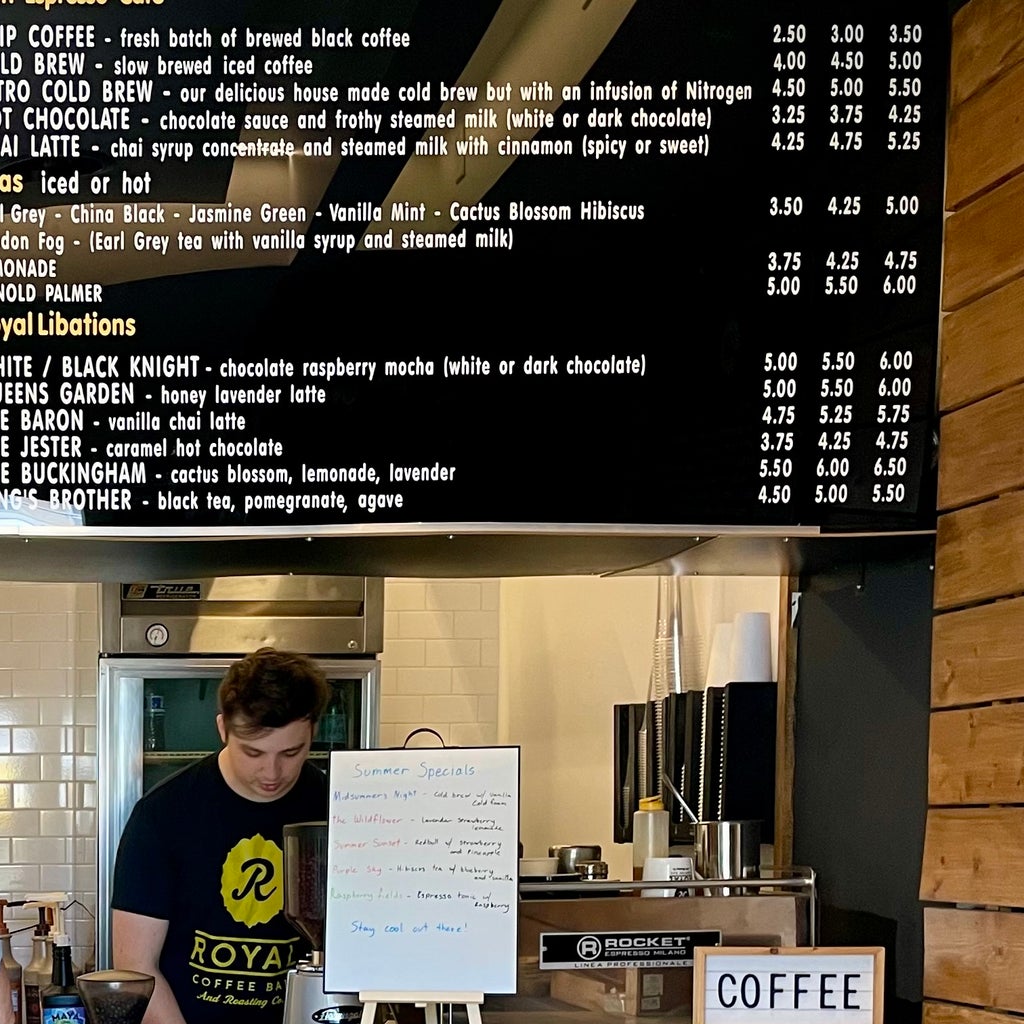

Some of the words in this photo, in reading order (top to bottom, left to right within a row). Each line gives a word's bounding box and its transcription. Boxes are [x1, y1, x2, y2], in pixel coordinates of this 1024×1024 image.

[29, 25, 94, 47] COFFEE
[121, 28, 159, 47] fresh
[170, 28, 211, 47] batch
[222, 28, 236, 47] of
[247, 28, 301, 47] brewed
[312, 28, 352, 47] black
[362, 28, 409, 47] coffee
[774, 25, 805, 42] 2.50
[832, 25, 863, 42] 3.00
[890, 25, 921, 42] 3.50
[42, 170, 78, 194] iced
[91, 177, 110, 194] or
[123, 171, 151, 194] hot
[768, 252, 801, 270] 3.75
[827, 252, 858, 269] 4.25
[885, 251, 916, 269] 4.75
[46, 284, 102, 302] PALMER
[767, 277, 800, 295] 5.00
[825, 276, 857, 294] 5.50
[884, 275, 915, 293] 6.00
[38, 312, 135, 336] Libations
[60, 382, 133, 404] GARDEN
[162, 385, 206, 408] honey
[216, 385, 281, 403] lavender
[291, 384, 325, 403] latte
[763, 379, 796, 398] 5.00
[821, 379, 853, 397] 5.50
[879, 378, 911, 396] 6.00
[21, 409, 83, 431] BARON
[109, 412, 159, 430] vanilla
[170, 411, 200, 430] chai
[211, 411, 245, 430] latte
[762, 406, 794, 424] 4.75
[820, 405, 852, 423] 5.25
[877, 405, 909, 423] 5.75
[352, 763, 410, 778] Summer
[417, 762, 475, 780] Specials
[231, 858, 276, 901] R
[351, 920, 376, 938] Stay
[384, 922, 404, 933] cool
[412, 923, 429, 933] out
[605, 937, 686, 948] ROCKET
[191, 936, 296, 970] ROYAL
[192, 974, 256, 992] COFFEE
[717, 973, 861, 1010] COFFEE
[197, 991, 220, 1003] And
[223, 995, 268, 1009] Roasting
